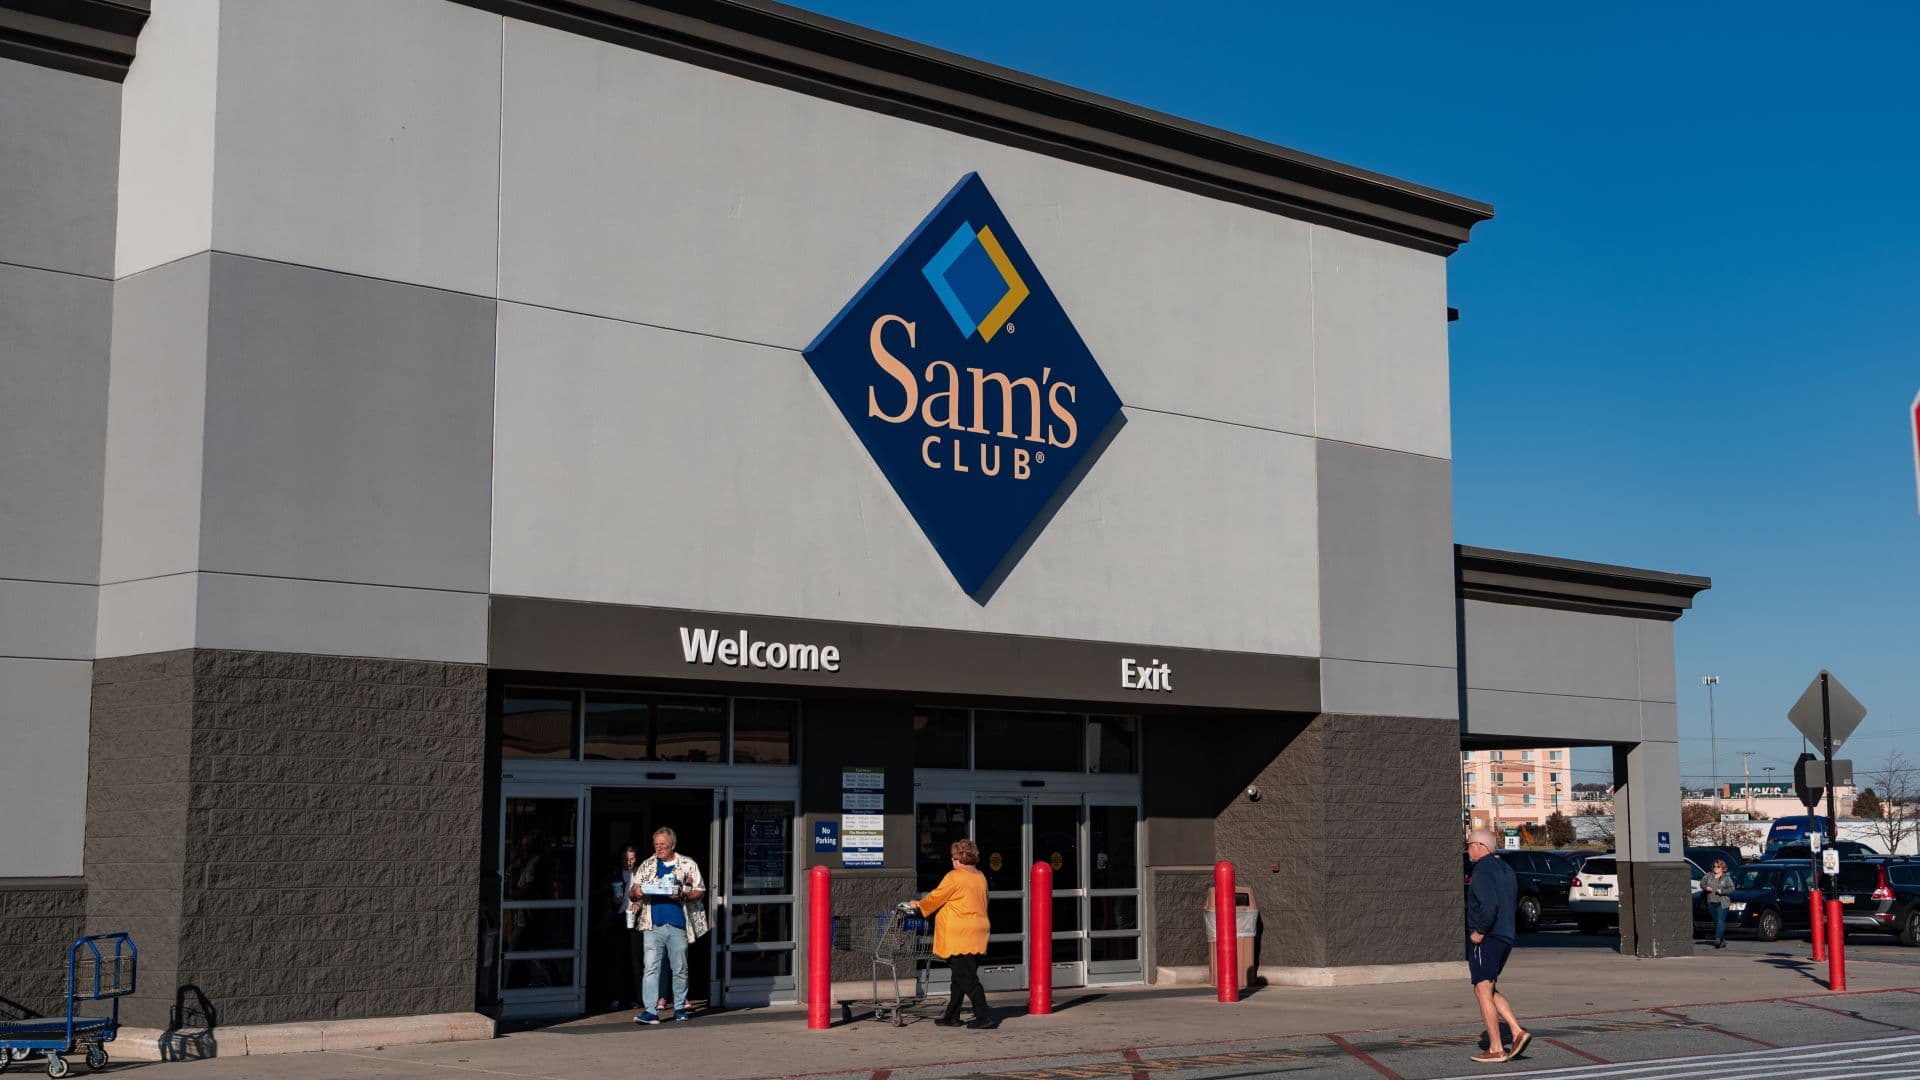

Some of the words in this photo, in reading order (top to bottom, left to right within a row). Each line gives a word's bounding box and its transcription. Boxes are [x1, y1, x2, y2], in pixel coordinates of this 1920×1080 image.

[868, 314, 1078, 449] Sam's
[679, 626, 841, 671] Welcome
[1121, 657, 1173, 691] Exit
[815, 837, 837, 846] Parking
[821, 827, 831, 835] No
